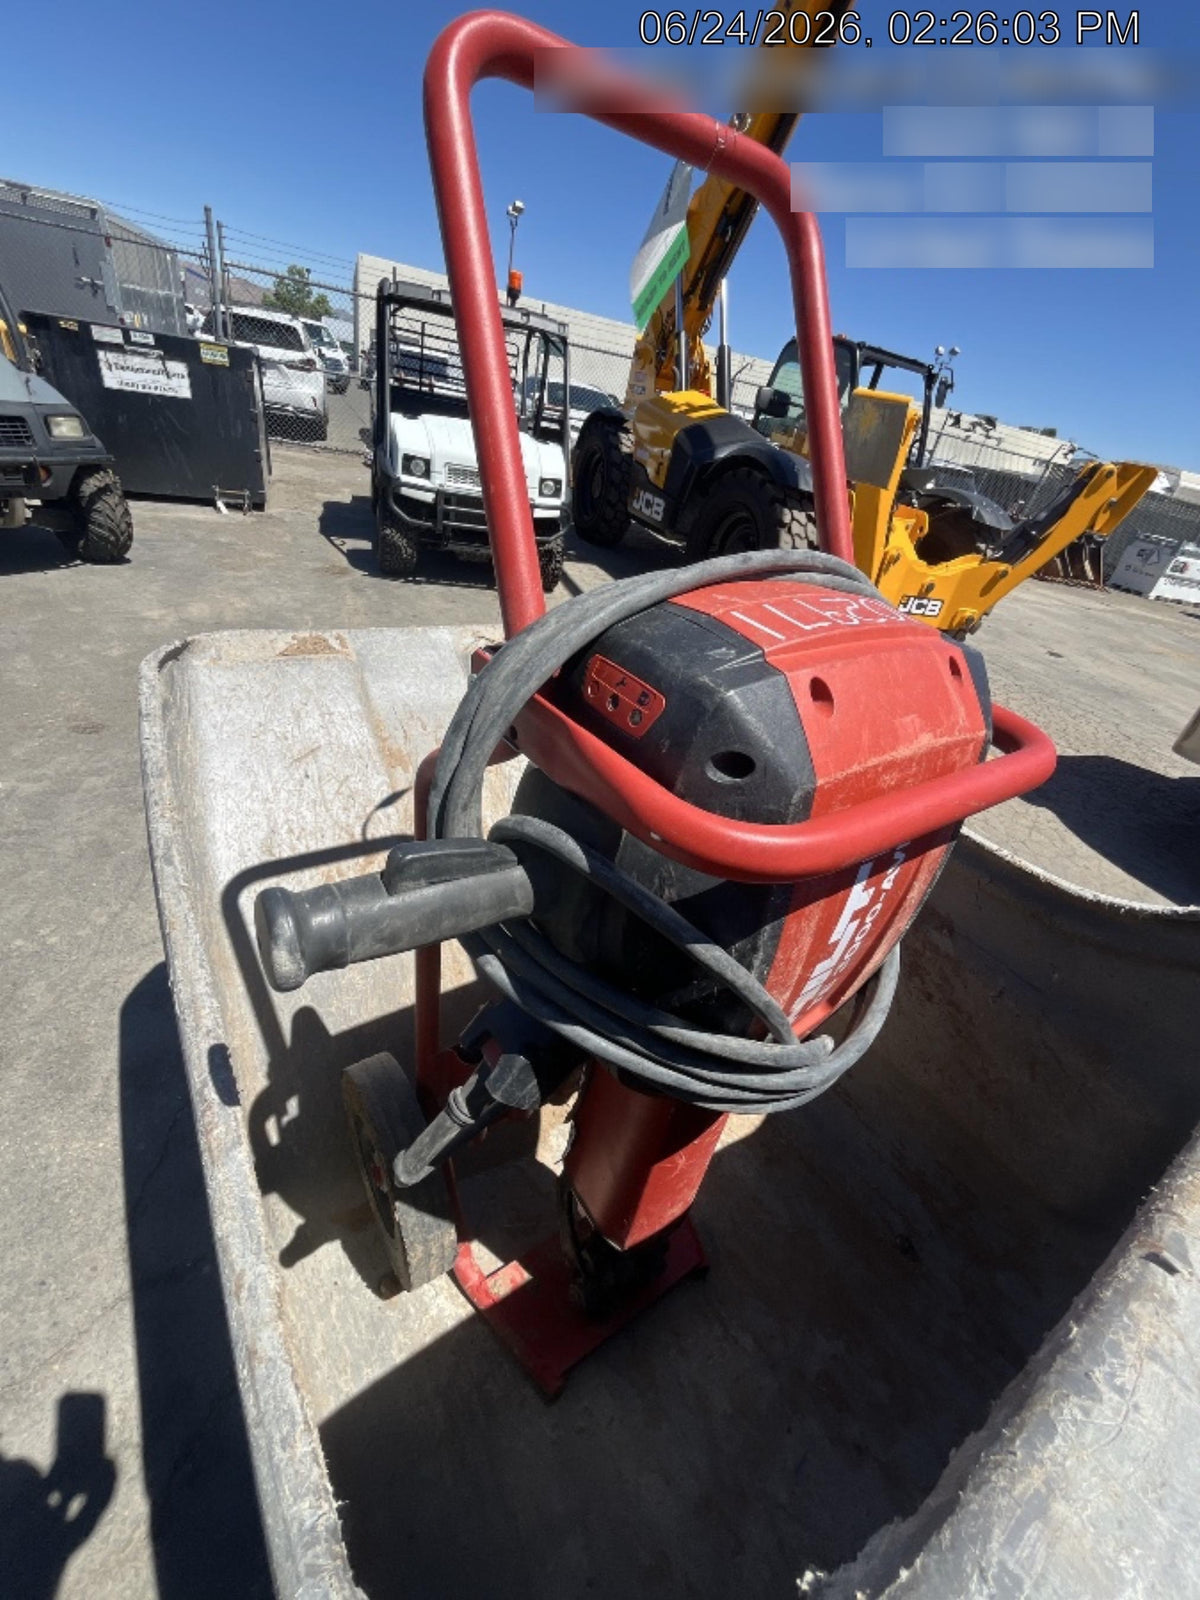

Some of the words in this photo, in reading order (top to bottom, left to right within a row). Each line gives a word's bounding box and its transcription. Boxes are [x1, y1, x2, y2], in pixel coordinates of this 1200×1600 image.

[632, 489, 666, 522] JCB
[898, 596, 942, 617] JCB
[788, 860, 876, 1023] HILT
